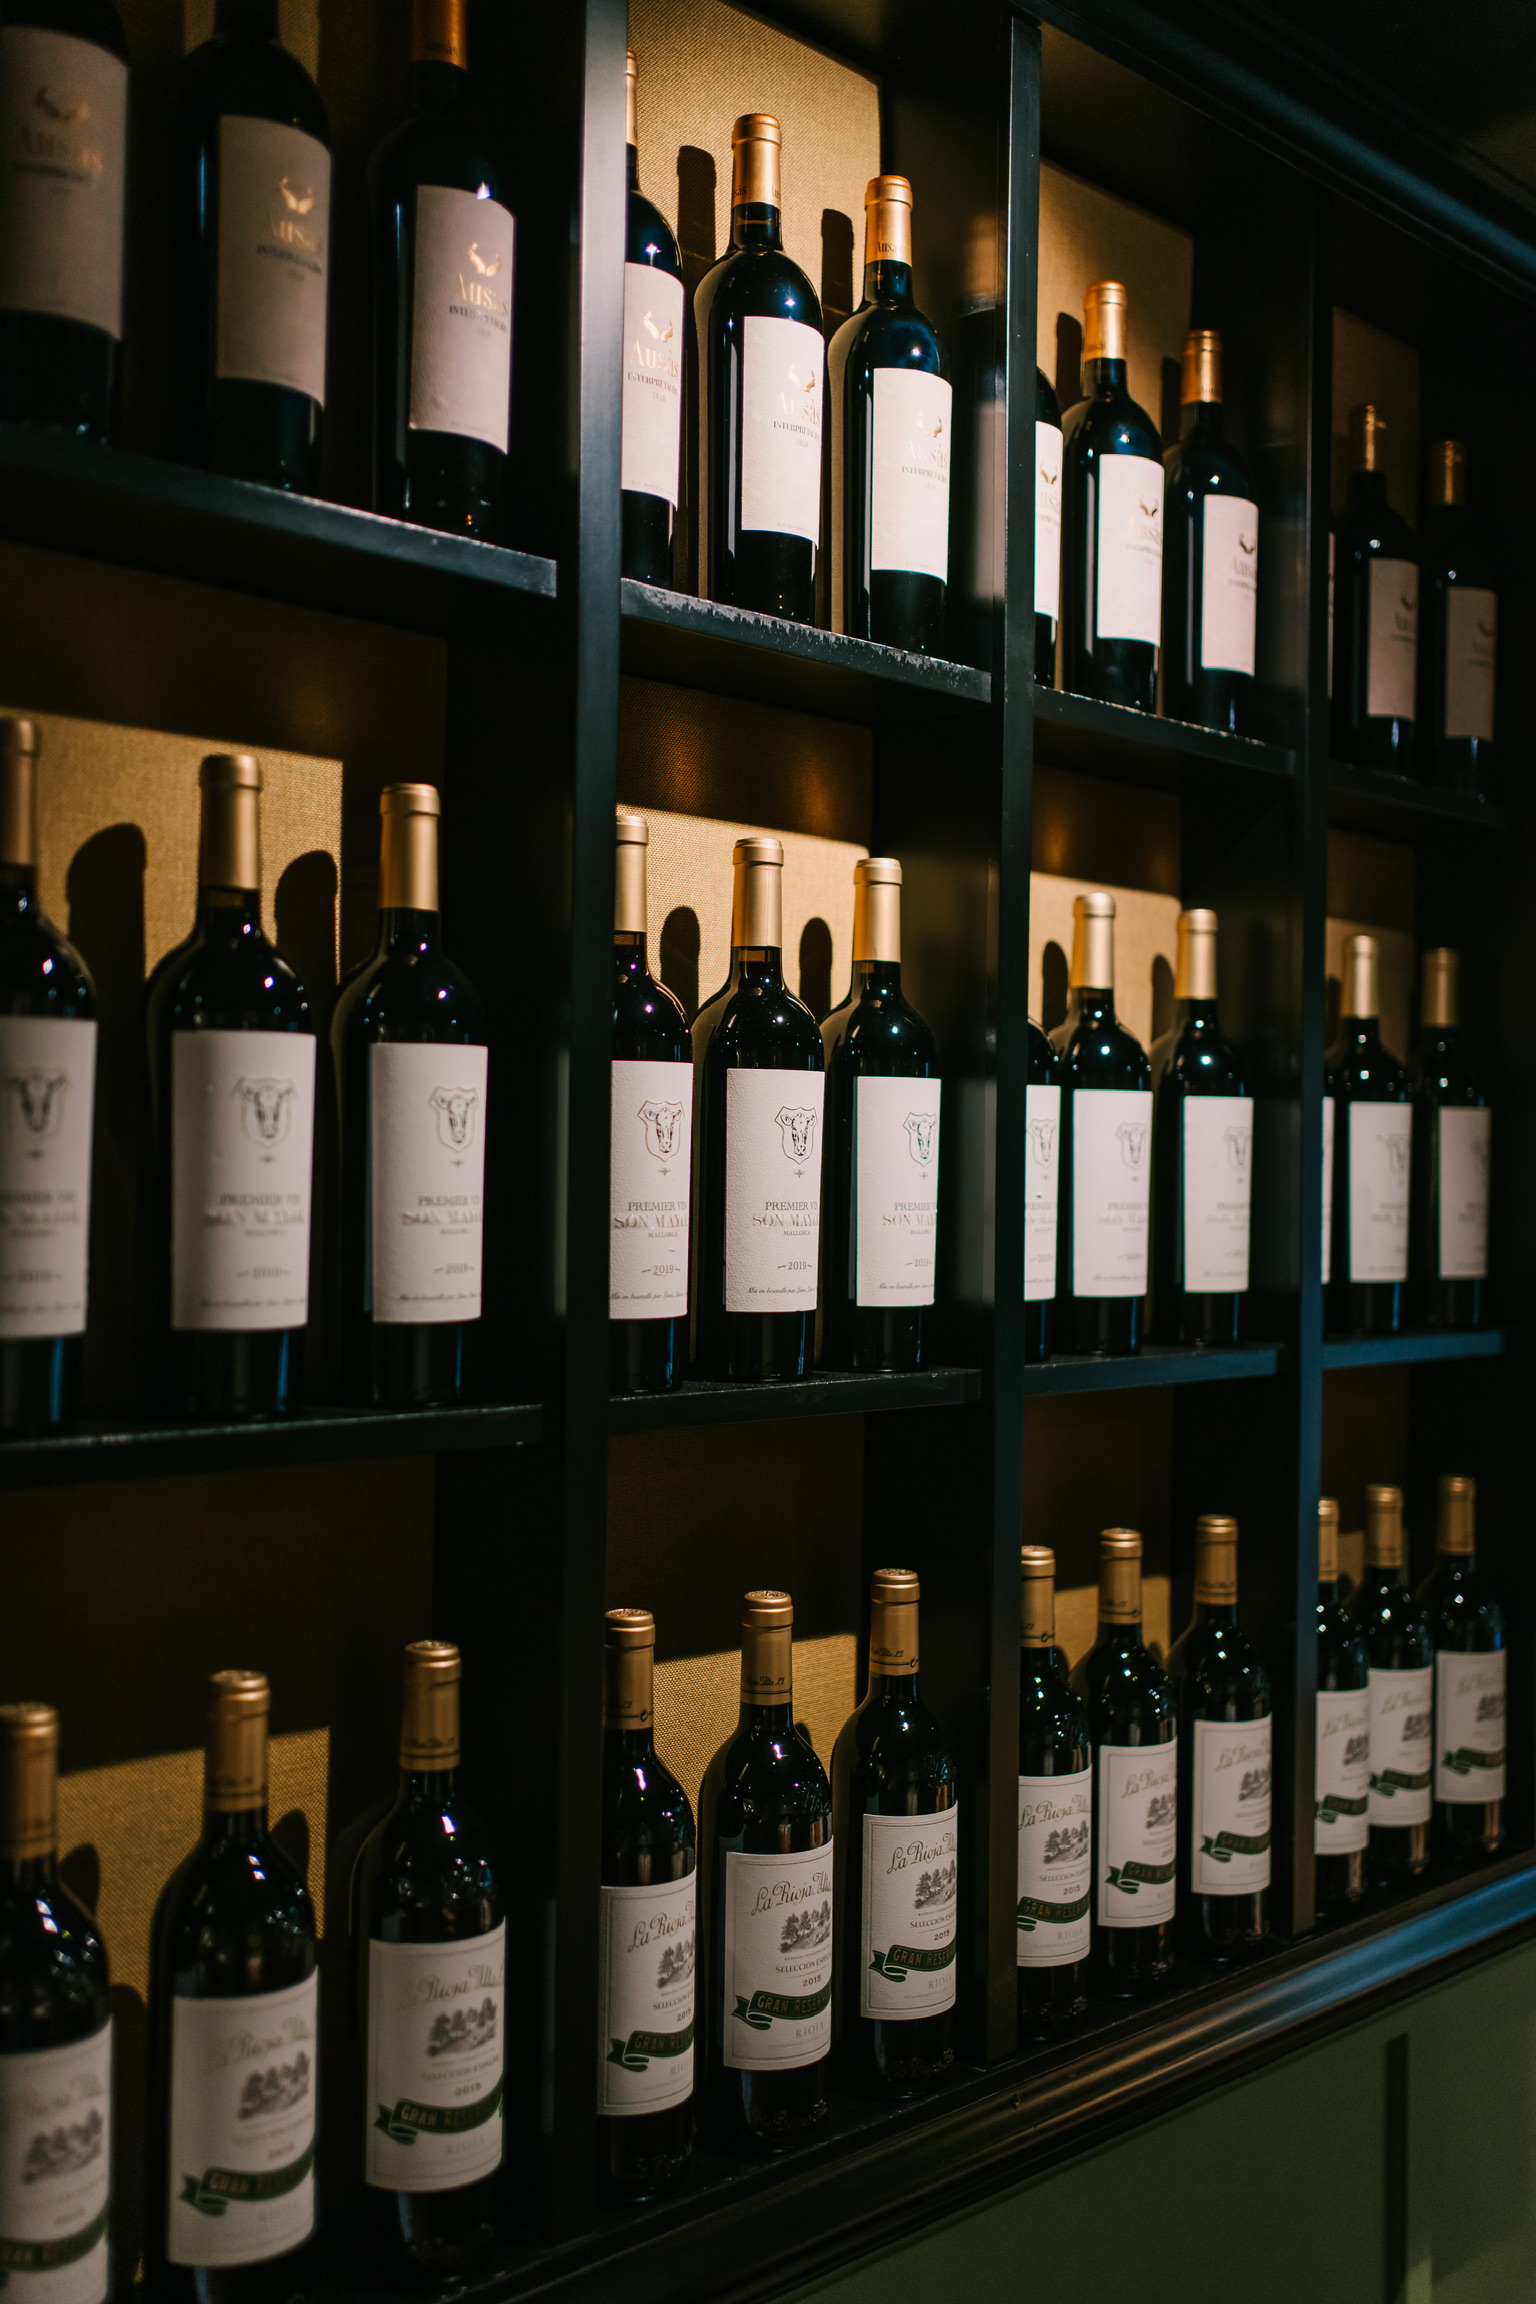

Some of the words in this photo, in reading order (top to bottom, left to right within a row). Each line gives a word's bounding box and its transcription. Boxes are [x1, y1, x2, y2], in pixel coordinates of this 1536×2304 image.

[628, 1200, 676, 1212] PREMIER
[765, 1201, 808, 1211] PREMIER
[894, 1202, 932, 1211] PREMIER
[612, 1214, 649, 1229] SON
[752, 1213, 784, 1227] SON
[882, 1212, 911, 1226] SON
[653, 1263, 675, 1275] 2019
[787, 1261, 807, 1271] 2019
[886, 1846, 907, 1874] La
[906, 1841, 943, 1865] Rioja
[750, 1885, 773, 1917] La
[772, 1880, 813, 1907] Rioja
[1024, 1900, 1052, 1917] GRAN
[627, 1920, 650, 1953] La
[649, 1912, 687, 1941] Rioja
[933, 1928, 950, 1941] 2015
[893, 1949, 922, 1966] GRAN
[775, 1960, 816, 1974] SELECCIÓN
[802, 1975, 822, 1987] 2015
[757, 1995, 789, 2013] GRAN
[634, 2034, 665, 2052] GRAN
[401, 2104, 438, 2127] GRAN
